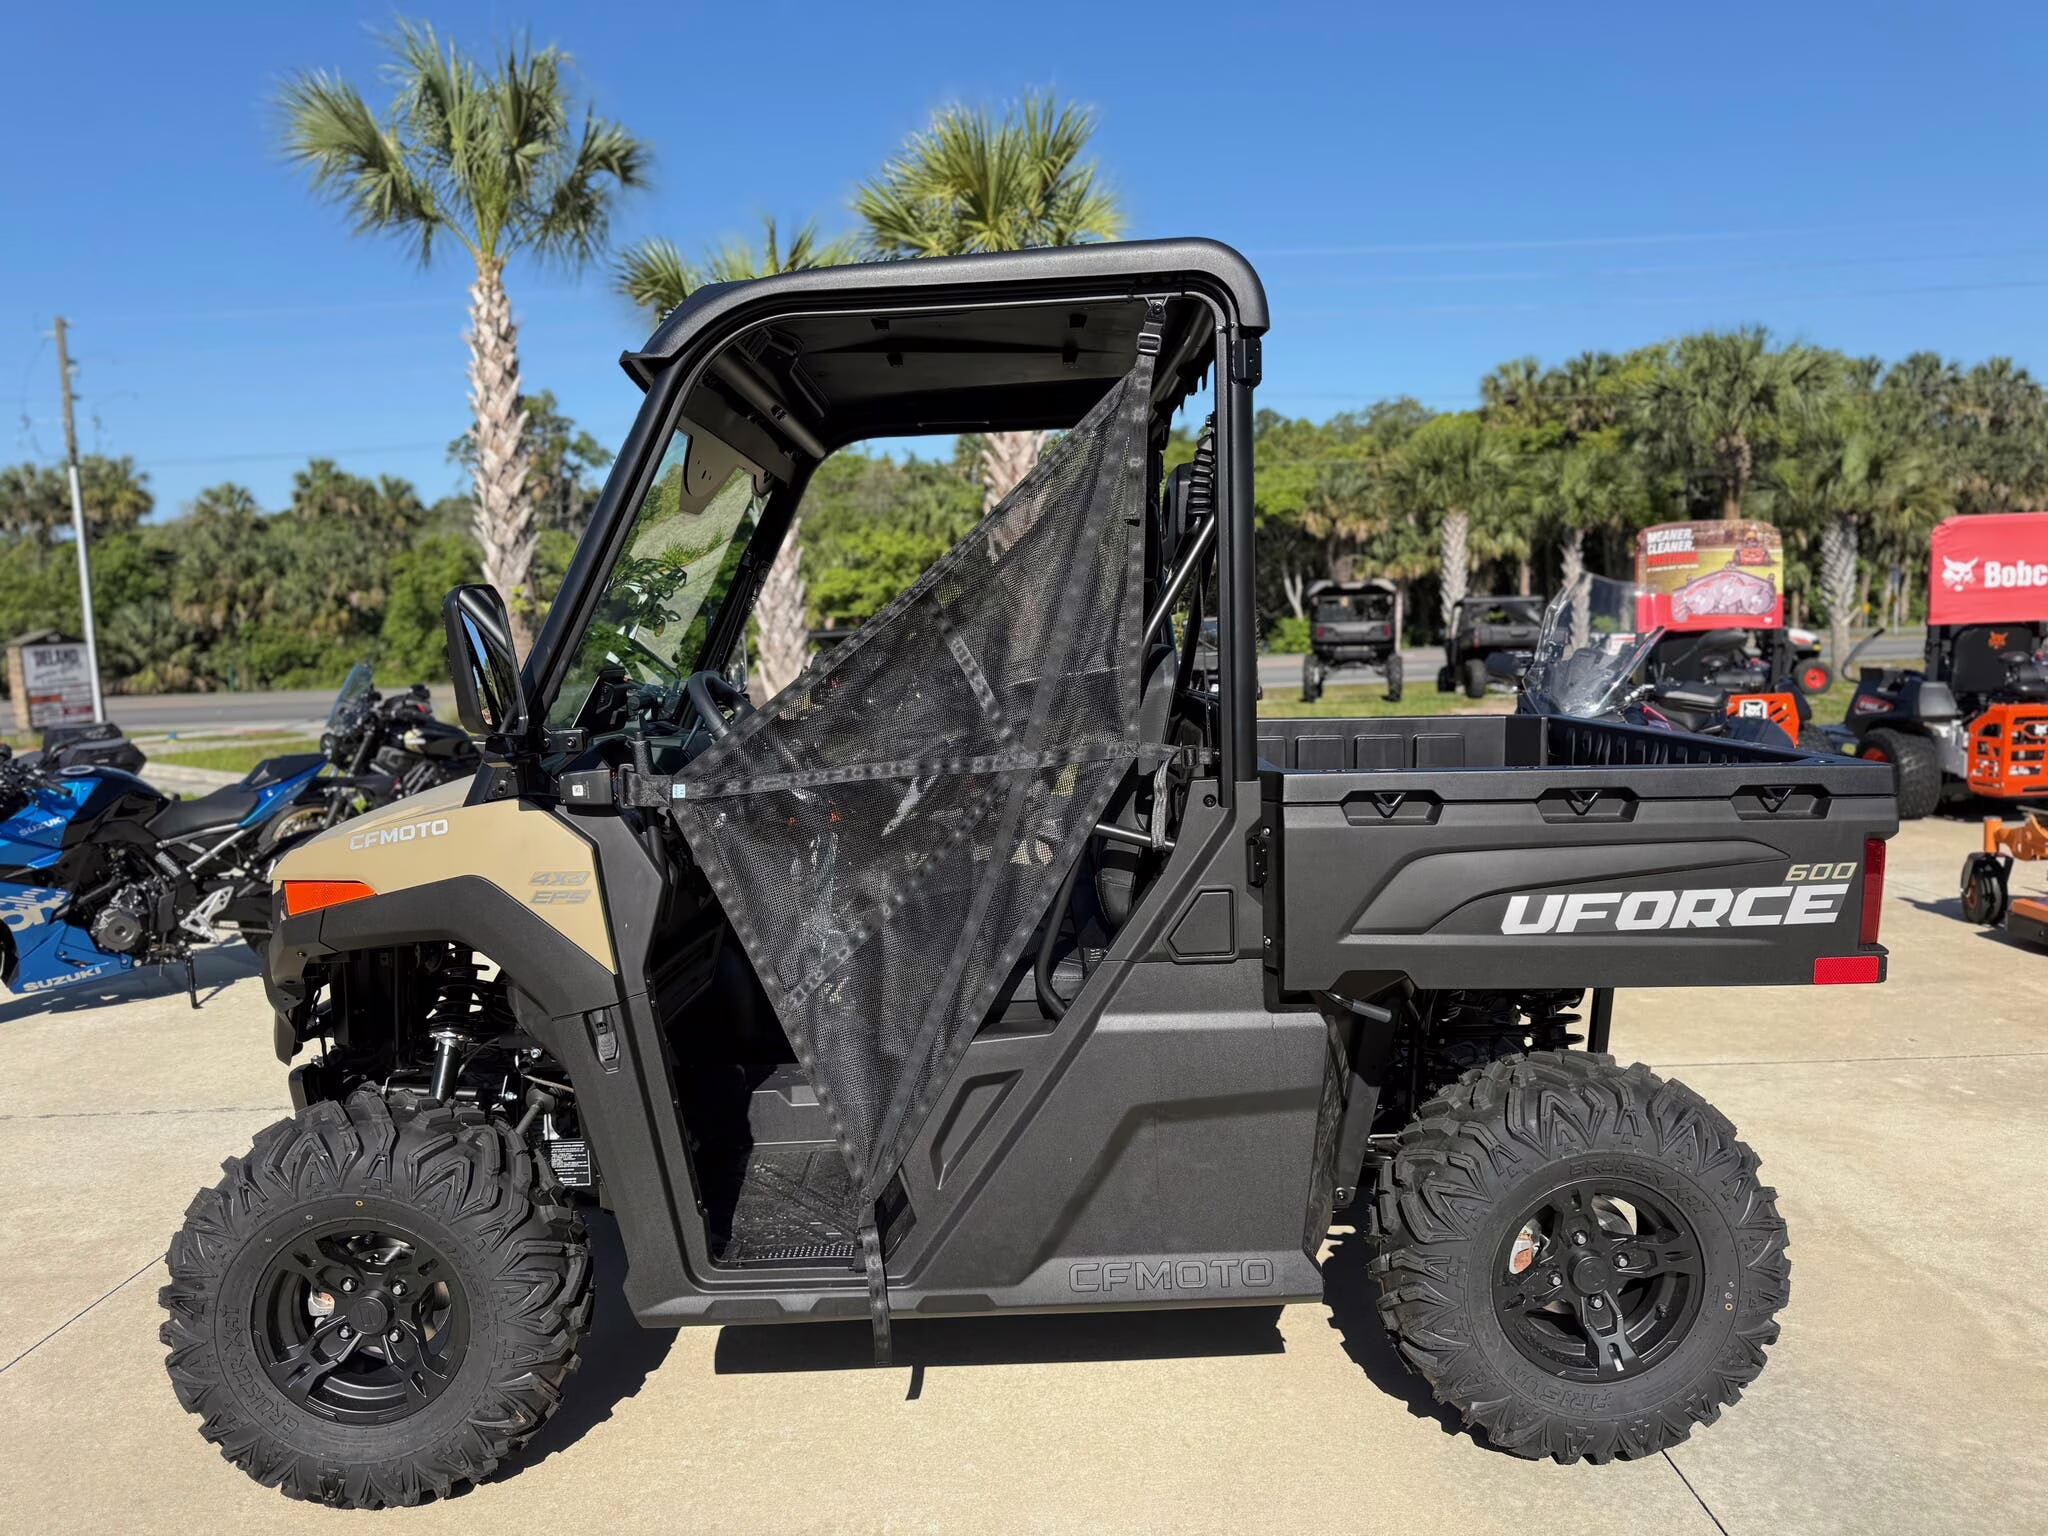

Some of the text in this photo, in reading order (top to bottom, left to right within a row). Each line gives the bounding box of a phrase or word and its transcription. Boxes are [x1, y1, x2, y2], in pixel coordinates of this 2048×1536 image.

[1647, 540, 1696, 555] CLEANER.
[350, 818, 449, 851] CFMOTO
[1785, 862, 1857, 881] 600
[529, 890, 592, 904] EPS
[1500, 883, 1850, 935] UFORCE
[23, 966, 102, 992] SUZUKI
[1069, 1258, 1274, 1293] CFMOTO
